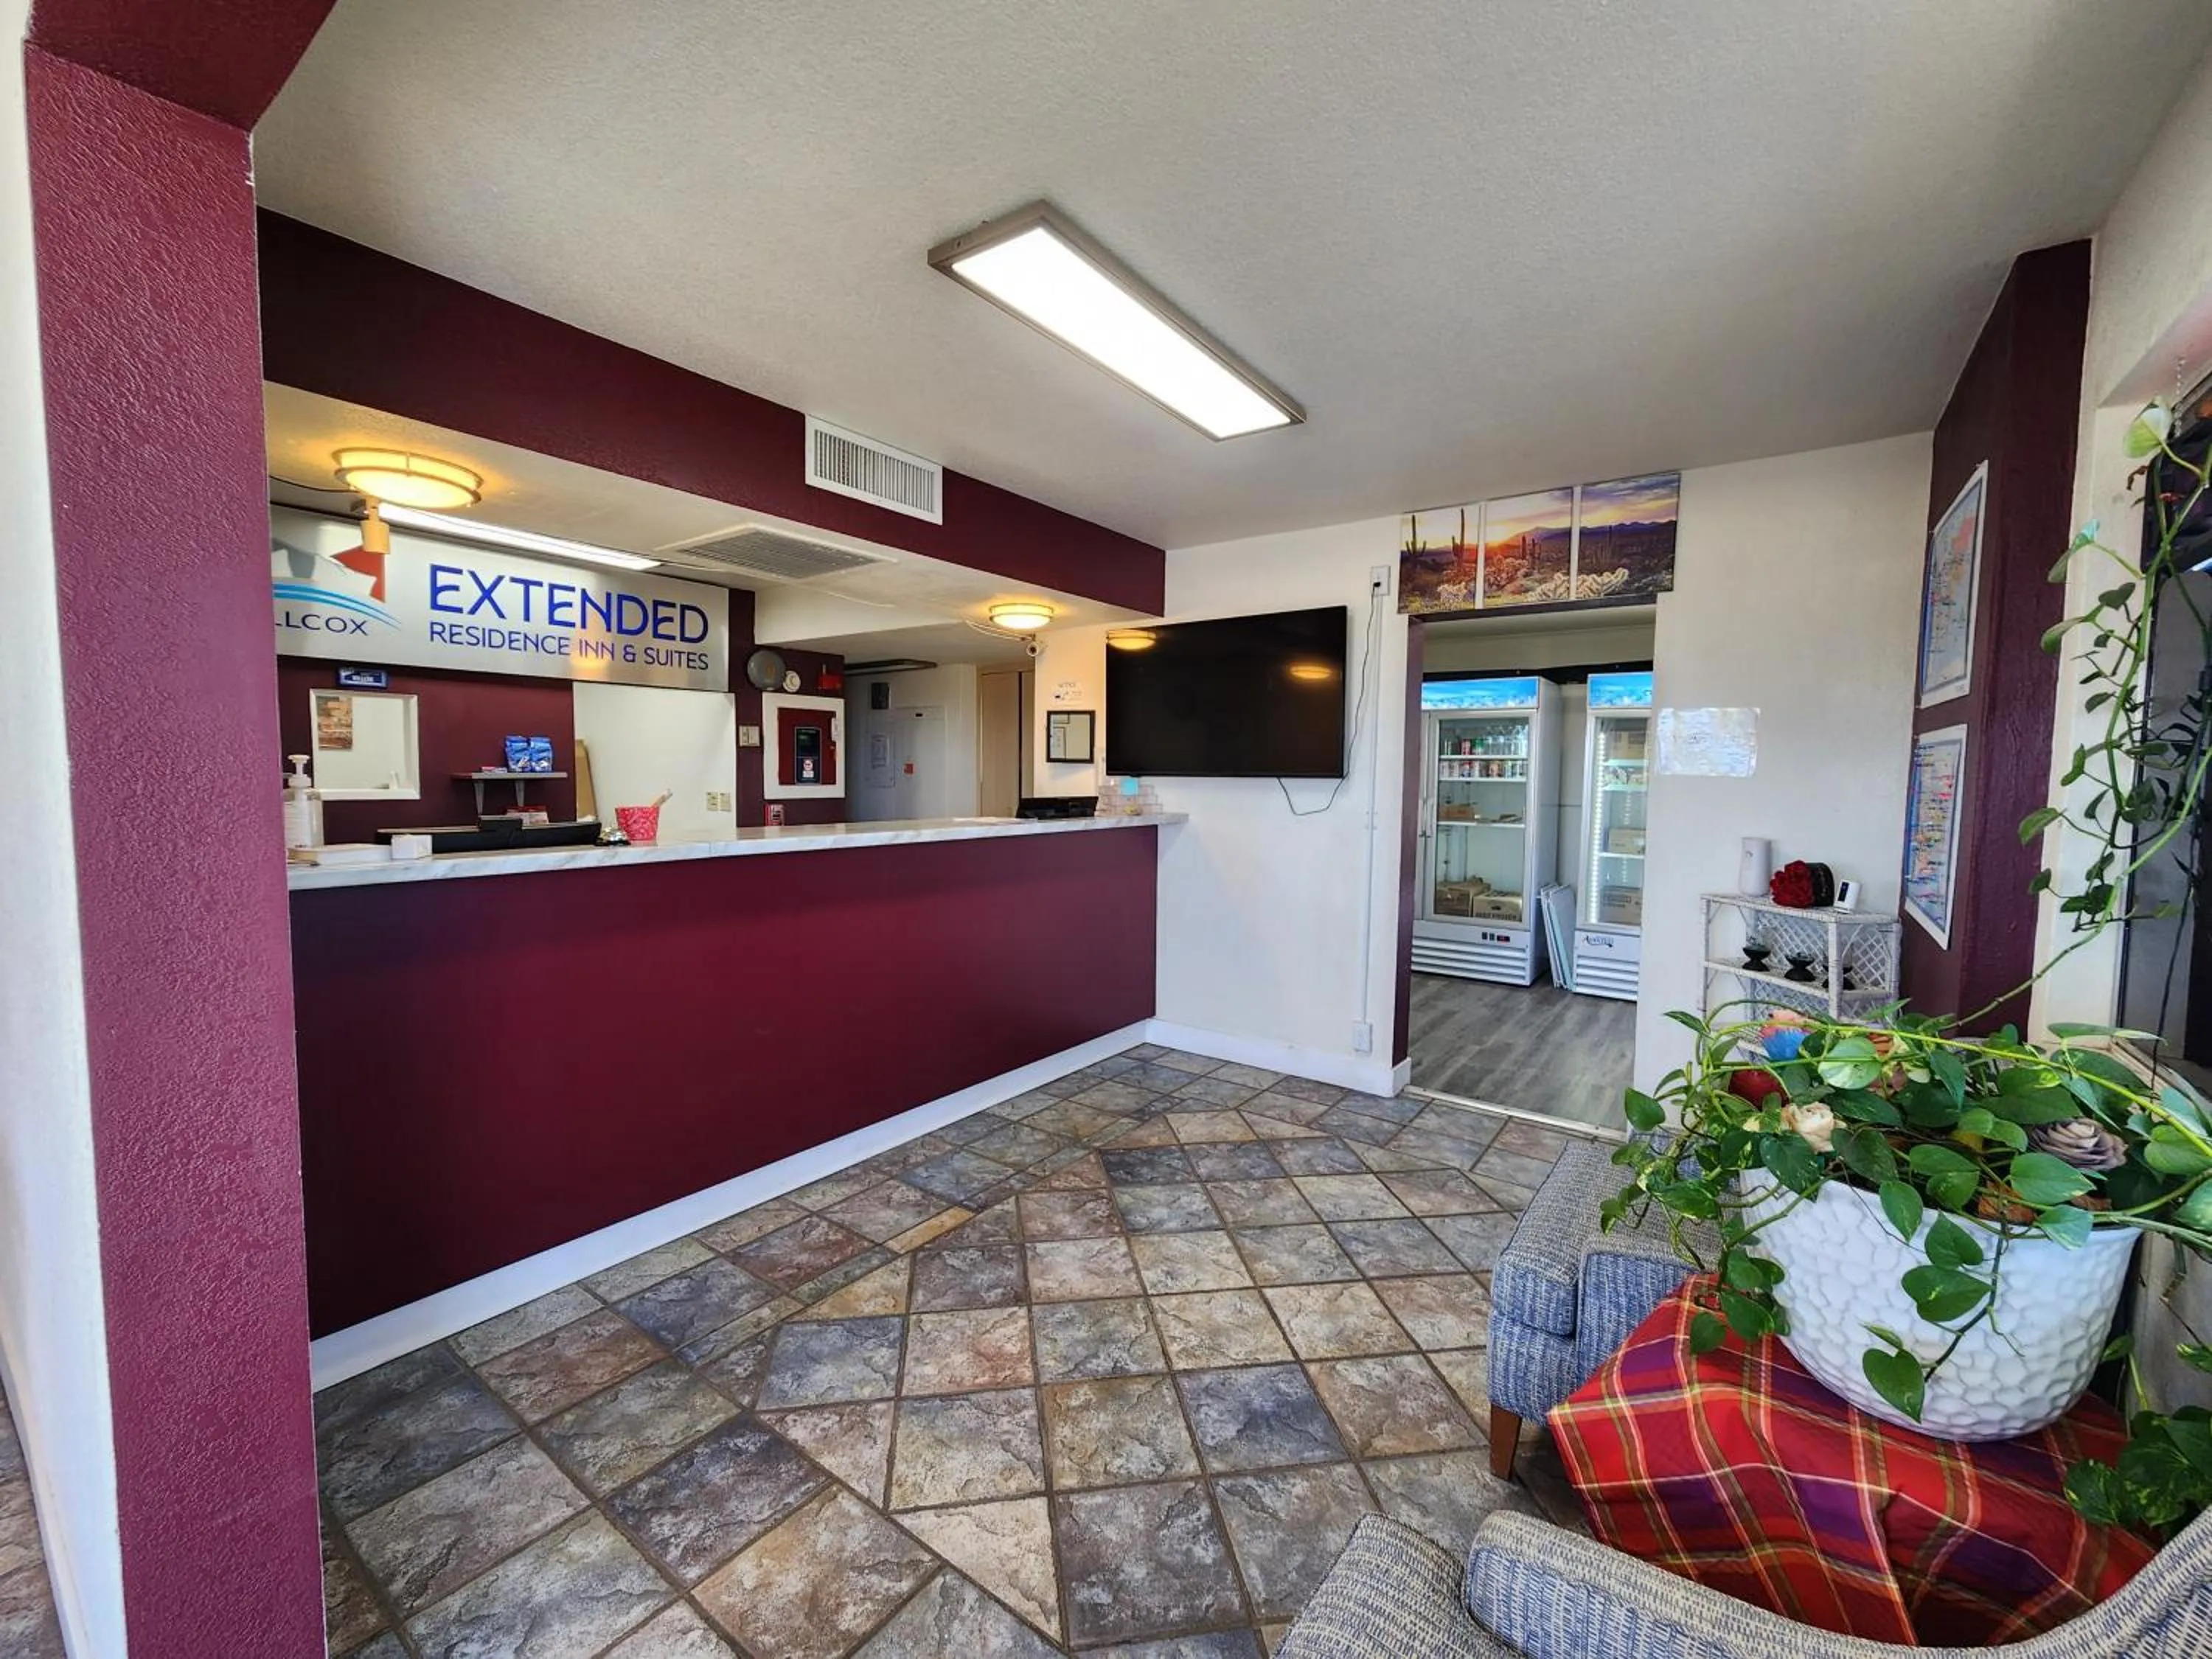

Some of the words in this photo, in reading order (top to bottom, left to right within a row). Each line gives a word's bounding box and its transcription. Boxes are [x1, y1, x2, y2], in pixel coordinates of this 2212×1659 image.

[430, 563, 709, 644] EXTENDED
[430, 621, 571, 655] RESIDENCE
[579, 639, 615, 661] INN
[623, 644, 636, 664] &
[644, 646, 709, 671] SUITES
